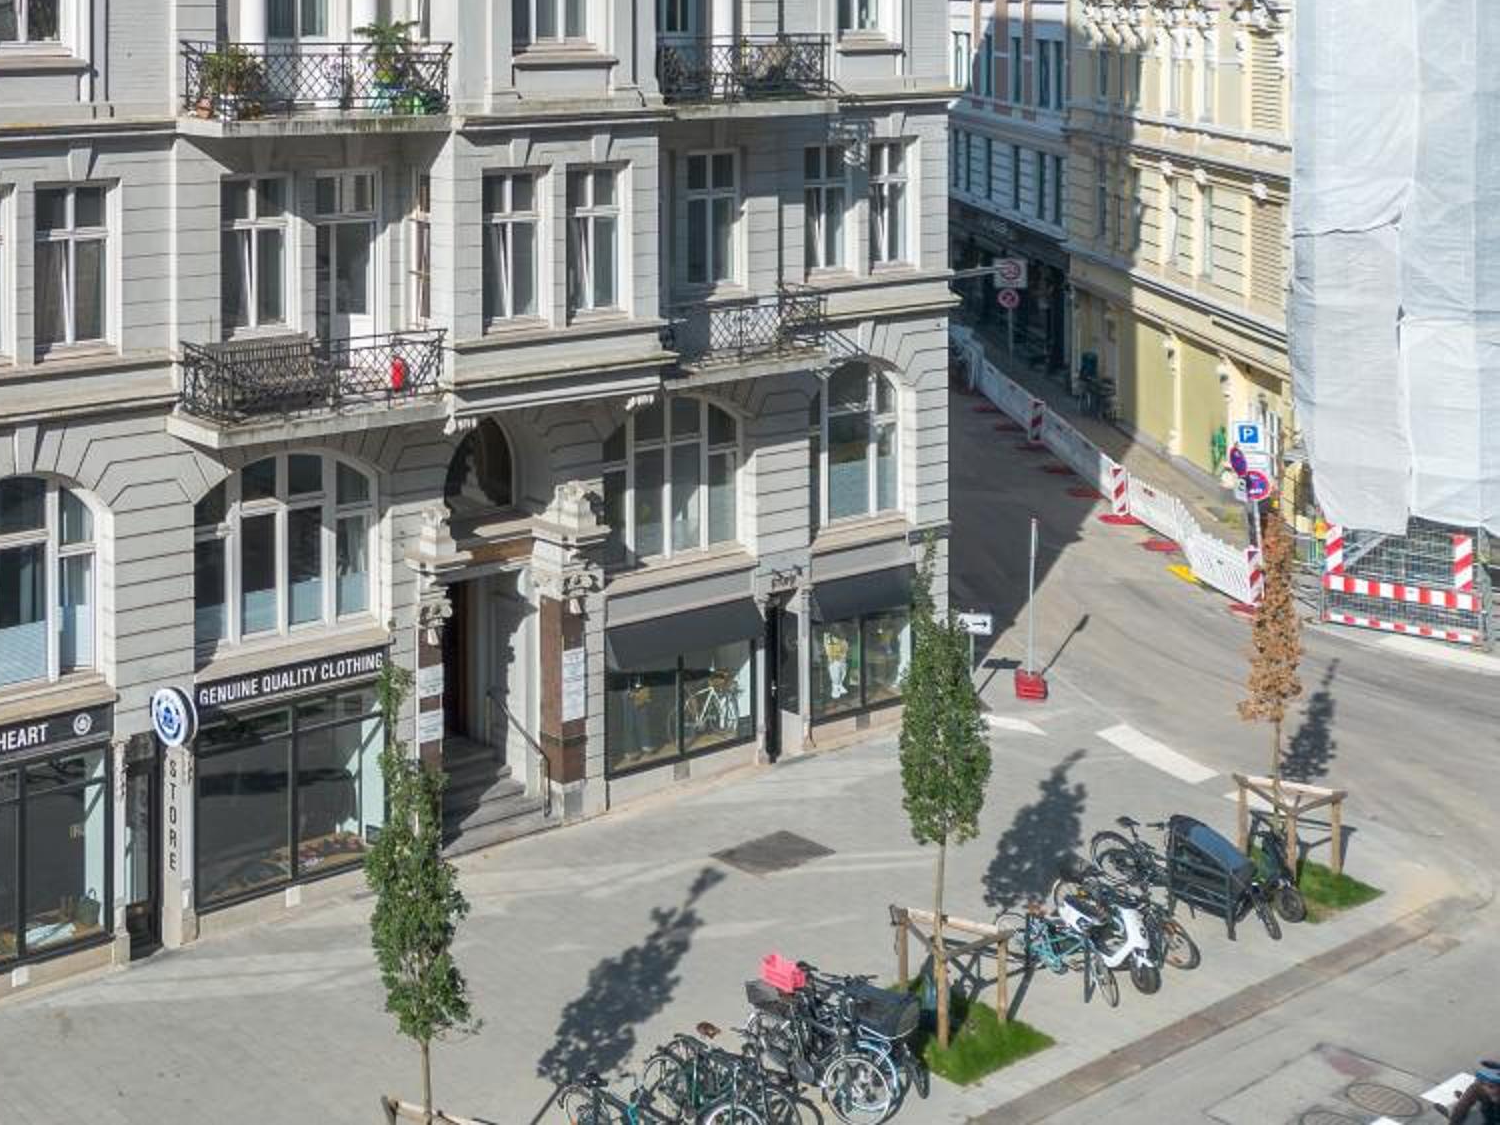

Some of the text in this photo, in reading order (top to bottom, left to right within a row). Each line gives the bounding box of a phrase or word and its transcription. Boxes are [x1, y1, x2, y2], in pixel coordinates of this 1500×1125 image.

[1243, 428, 1255, 444] P
[200, 652, 384, 705] GENUINE QUALITY CLOTHING
[168, 760, 178, 872] STORE
